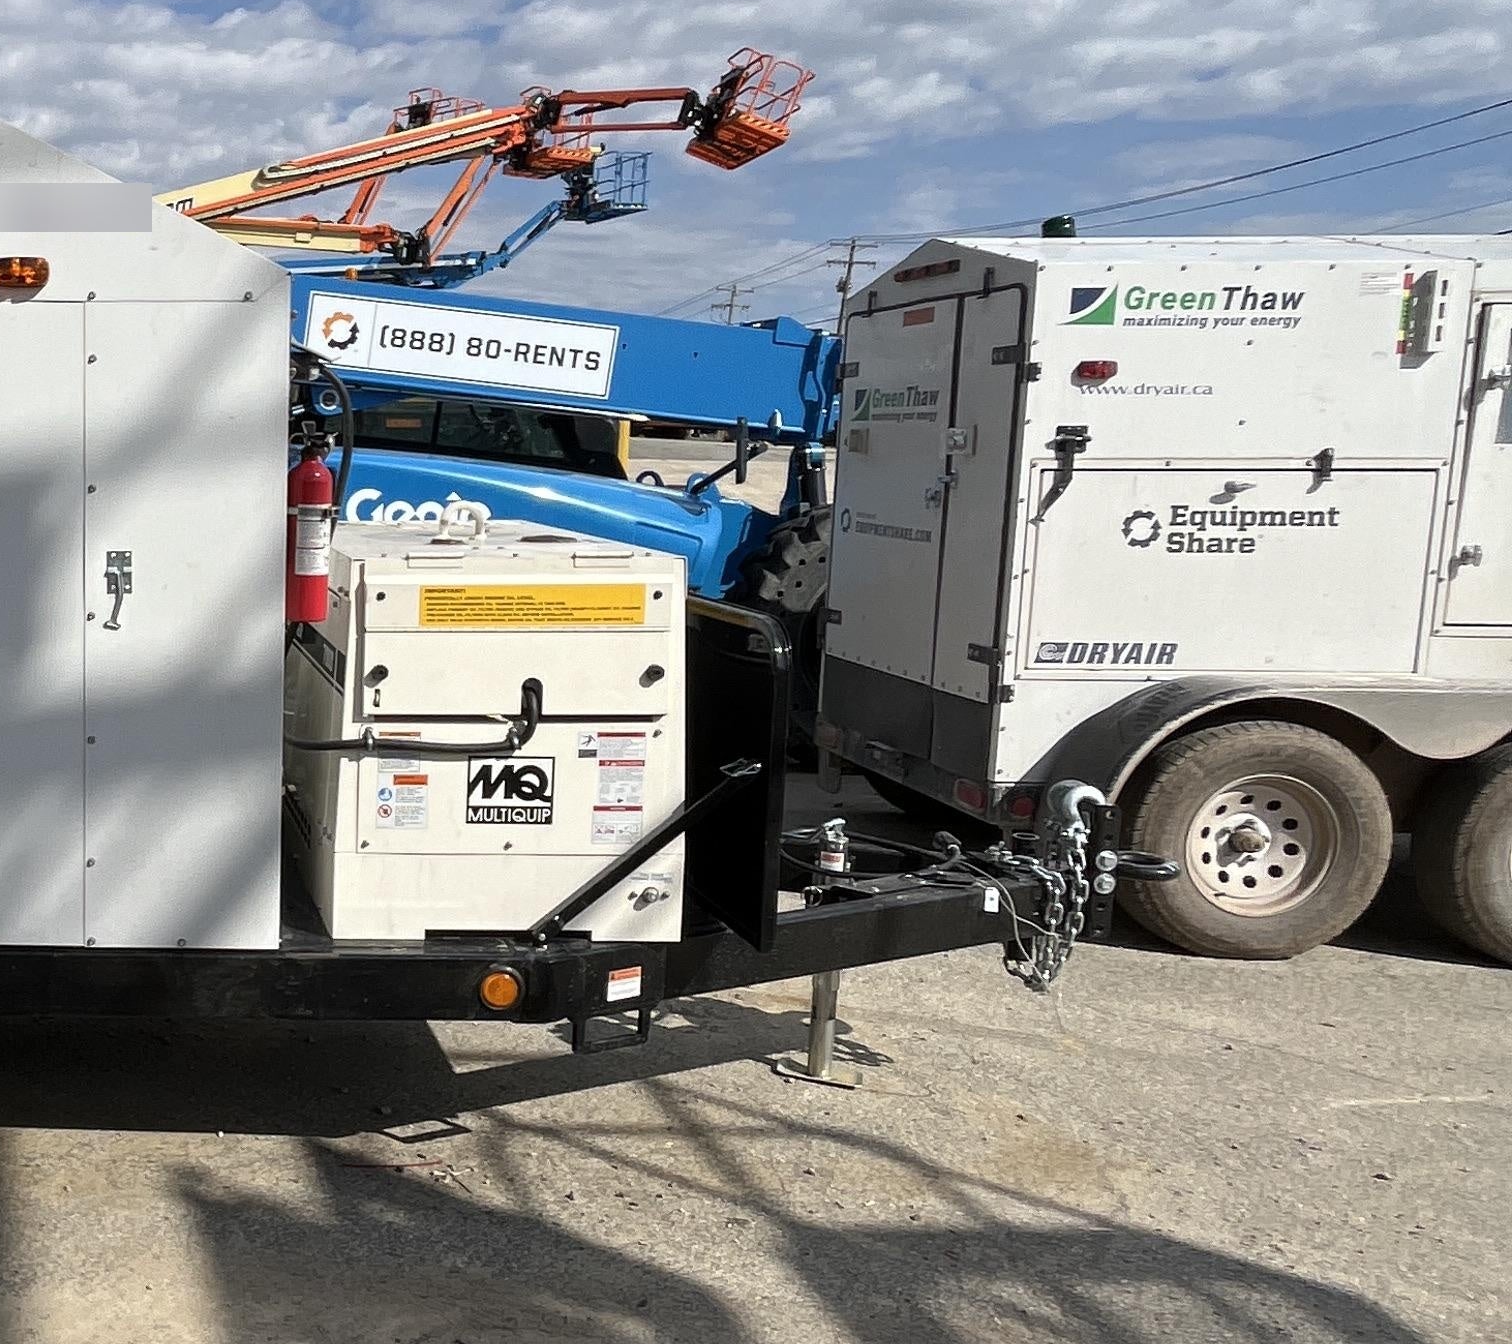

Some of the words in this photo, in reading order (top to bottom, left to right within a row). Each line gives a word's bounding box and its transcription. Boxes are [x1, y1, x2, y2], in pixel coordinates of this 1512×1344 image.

[1122, 314, 1208, 330] maximizing
[1211, 316, 1245, 330] your
[1249, 315, 1302, 330] energy
[379, 324, 455, 356] (888)
[466, 337, 602, 372] 80-RENTS
[1080, 382, 1214, 396] www.dryair.ca
[1169, 505, 1340, 531] Equipment
[1166, 531, 1256, 554] Share
[1065, 642, 1179, 665] DRYAIR
[467, 764, 553, 804] MQ
[468, 807, 552, 824] MULTIQUIP
